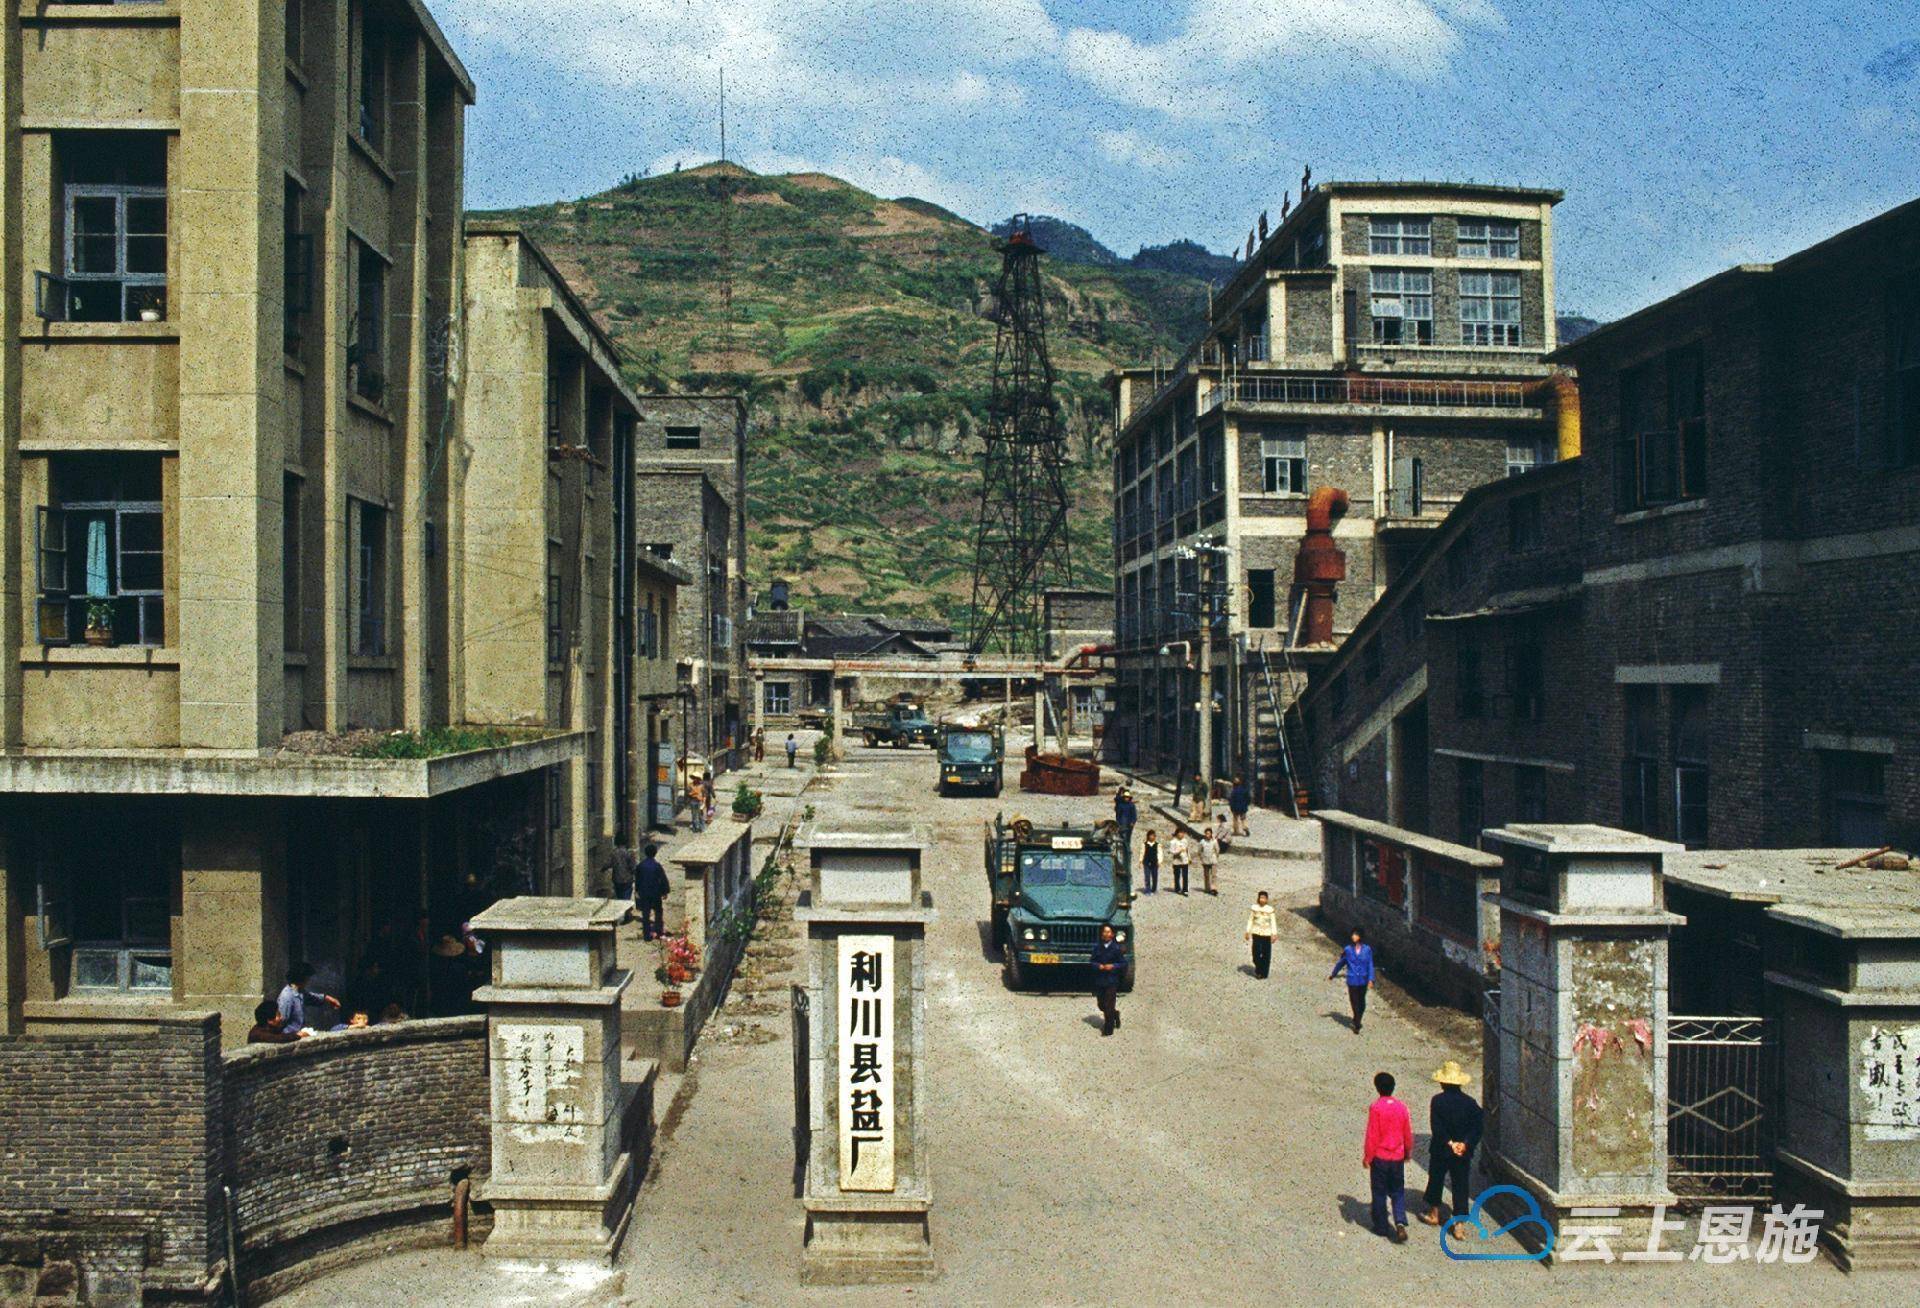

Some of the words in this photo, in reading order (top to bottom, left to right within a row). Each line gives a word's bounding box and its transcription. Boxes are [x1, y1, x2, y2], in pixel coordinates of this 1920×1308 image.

[850, 950, 883, 1177] 利川县盐厂
